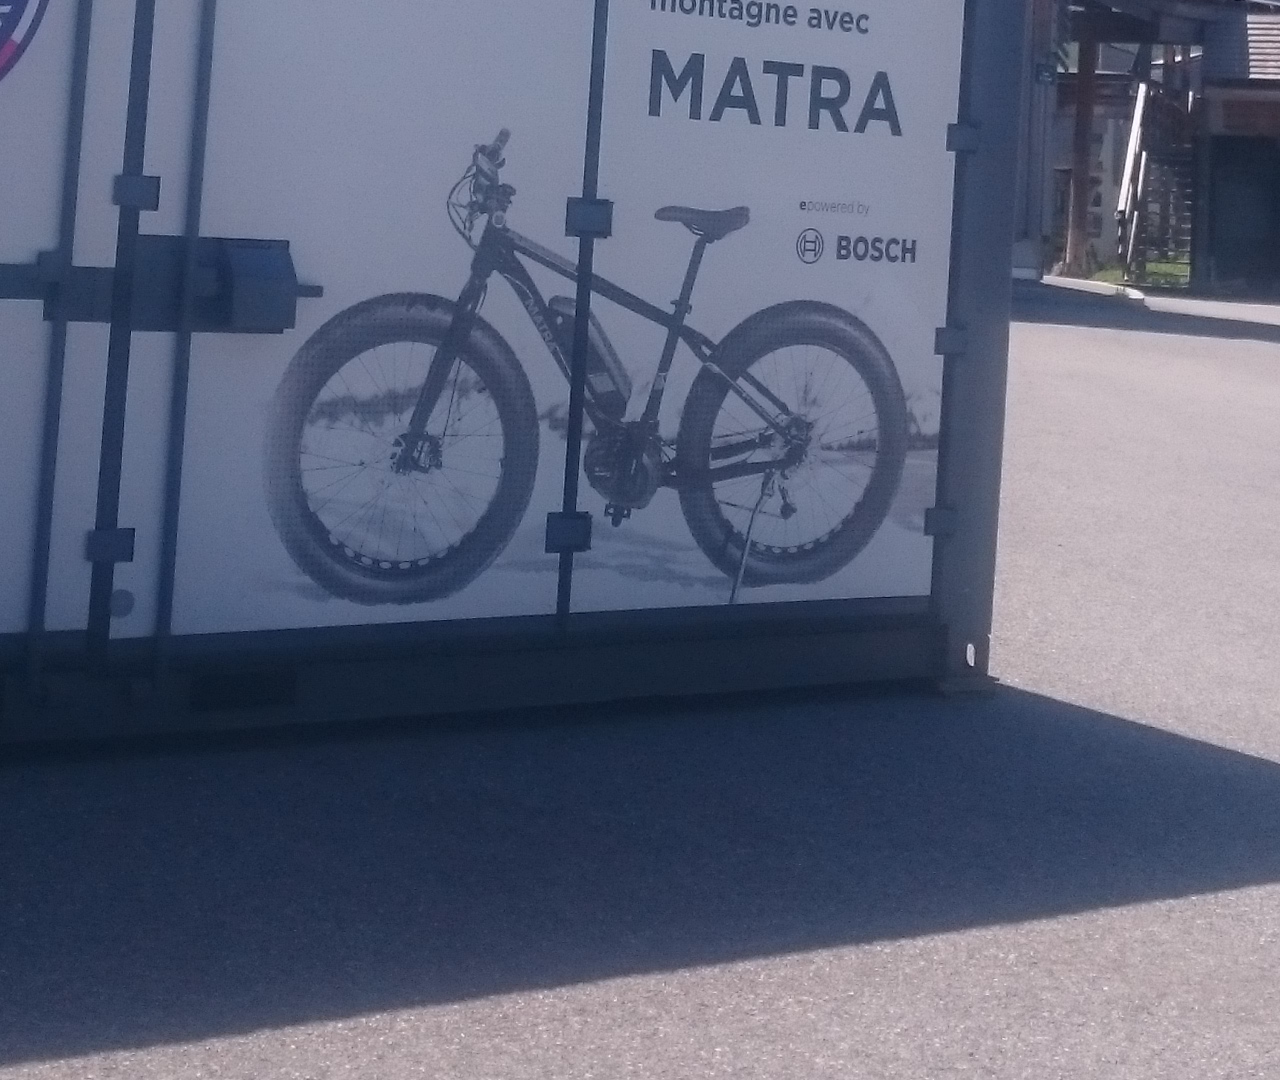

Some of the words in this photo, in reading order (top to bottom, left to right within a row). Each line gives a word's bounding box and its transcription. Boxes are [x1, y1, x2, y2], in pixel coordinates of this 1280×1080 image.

[806, 7, 870, 35] avec
[648, 48, 903, 138] MATRA
[799, 199, 854, 215] epowered
[856, 201, 870, 217] by
[835, 235, 917, 264] BOSCH
